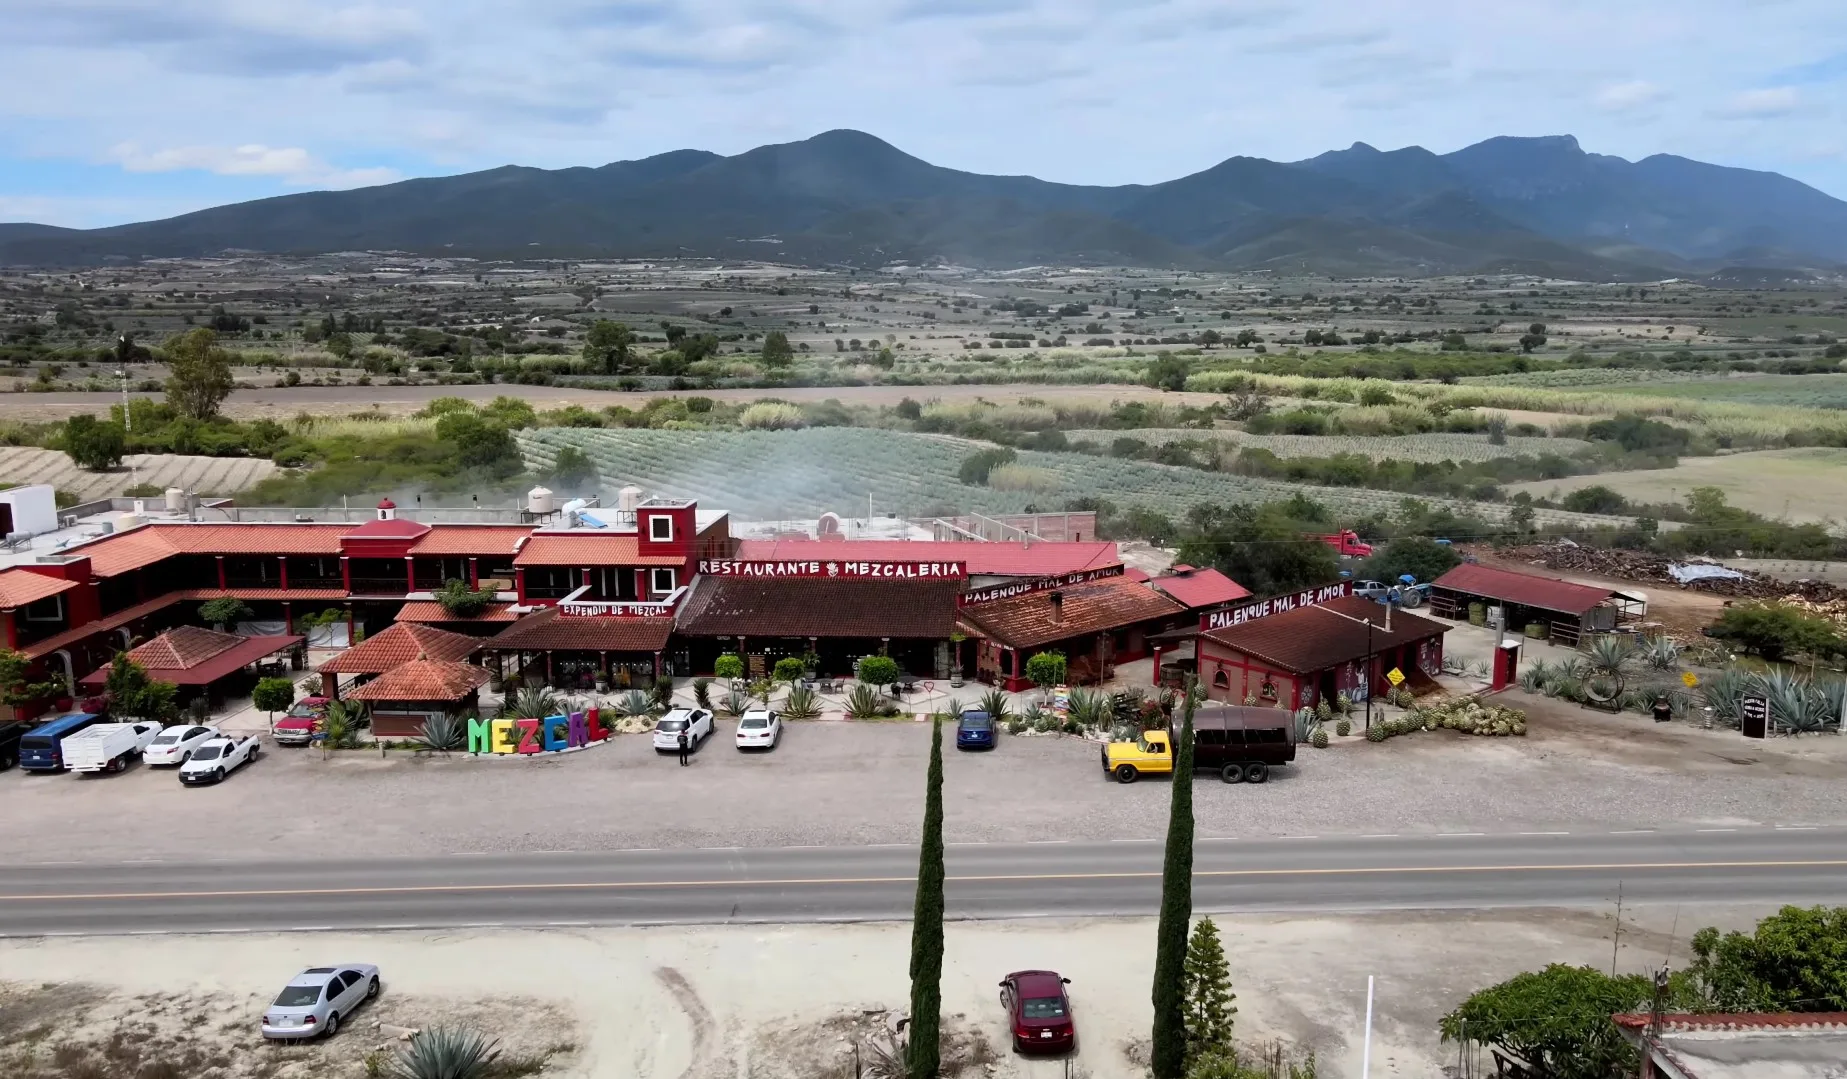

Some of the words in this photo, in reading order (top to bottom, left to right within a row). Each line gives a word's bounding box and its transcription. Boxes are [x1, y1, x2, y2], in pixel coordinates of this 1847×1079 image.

[699, 560, 820, 577] RESTAURANTE
[845, 562, 960, 578] MEZCALERIA
[964, 583, 1032, 604] PALENQUE
[1038, 578, 1063, 591] MAL
[1069, 573, 1084, 584] DE
[563, 604, 608, 617] EXPENDIO
[611, 605, 624, 615] DE
[629, 605, 668, 617] MEZCAL
[1209, 600, 1270, 628] PALENQUE
[1273, 595, 1296, 615] MAL
[1299, 590, 1314, 607] DE
[1317, 583, 1345, 603] AMOR
[467, 706, 609, 754] MEZCAL
